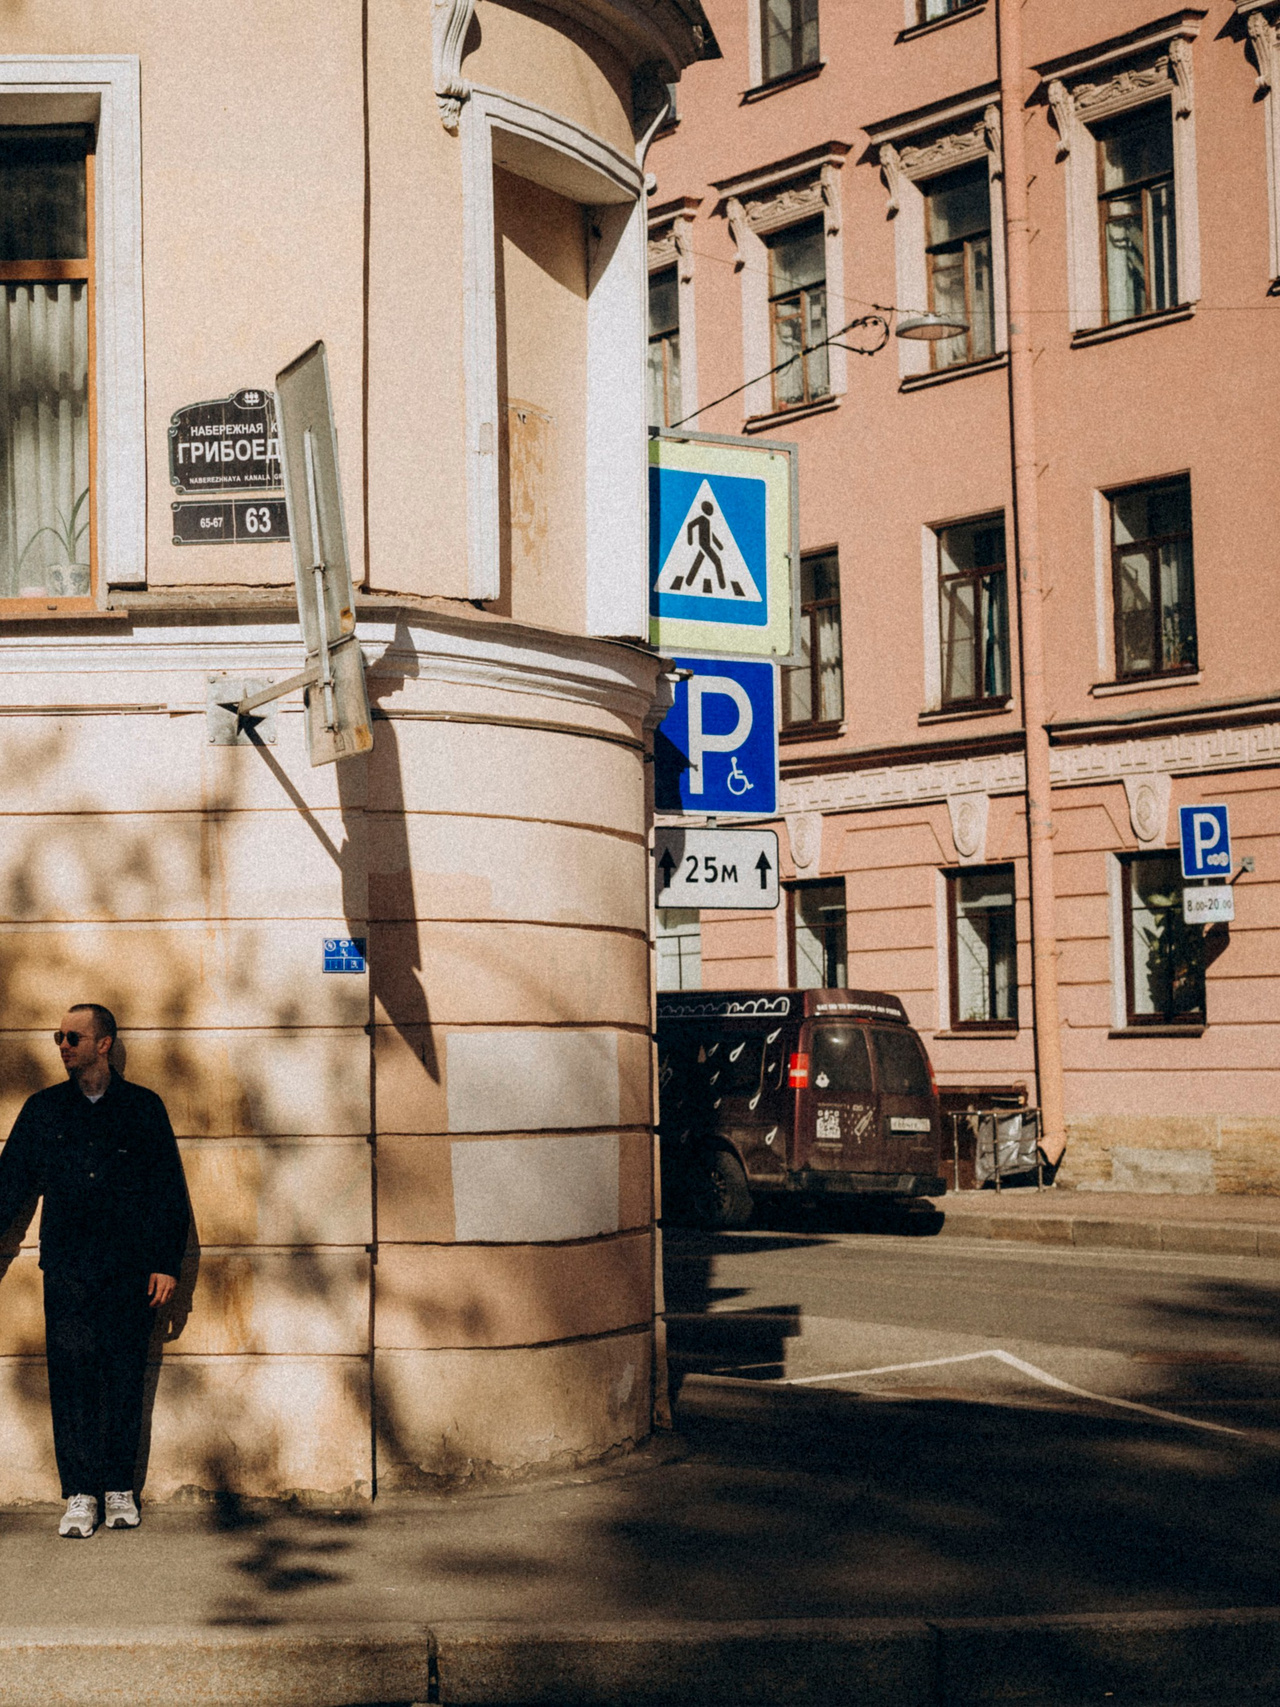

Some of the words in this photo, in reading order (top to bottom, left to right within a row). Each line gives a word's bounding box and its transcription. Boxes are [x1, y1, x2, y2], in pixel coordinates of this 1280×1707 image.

[190, 423, 264, 437] НАБЕРЕЖНАЯ
[189, 476, 241, 484] NABEREZHNAYA
[200, 517, 223, 529] 65-67
[245, 507, 271, 533] 63
[687, 674, 753, 794] P
[1193, 813, 1221, 869] P
